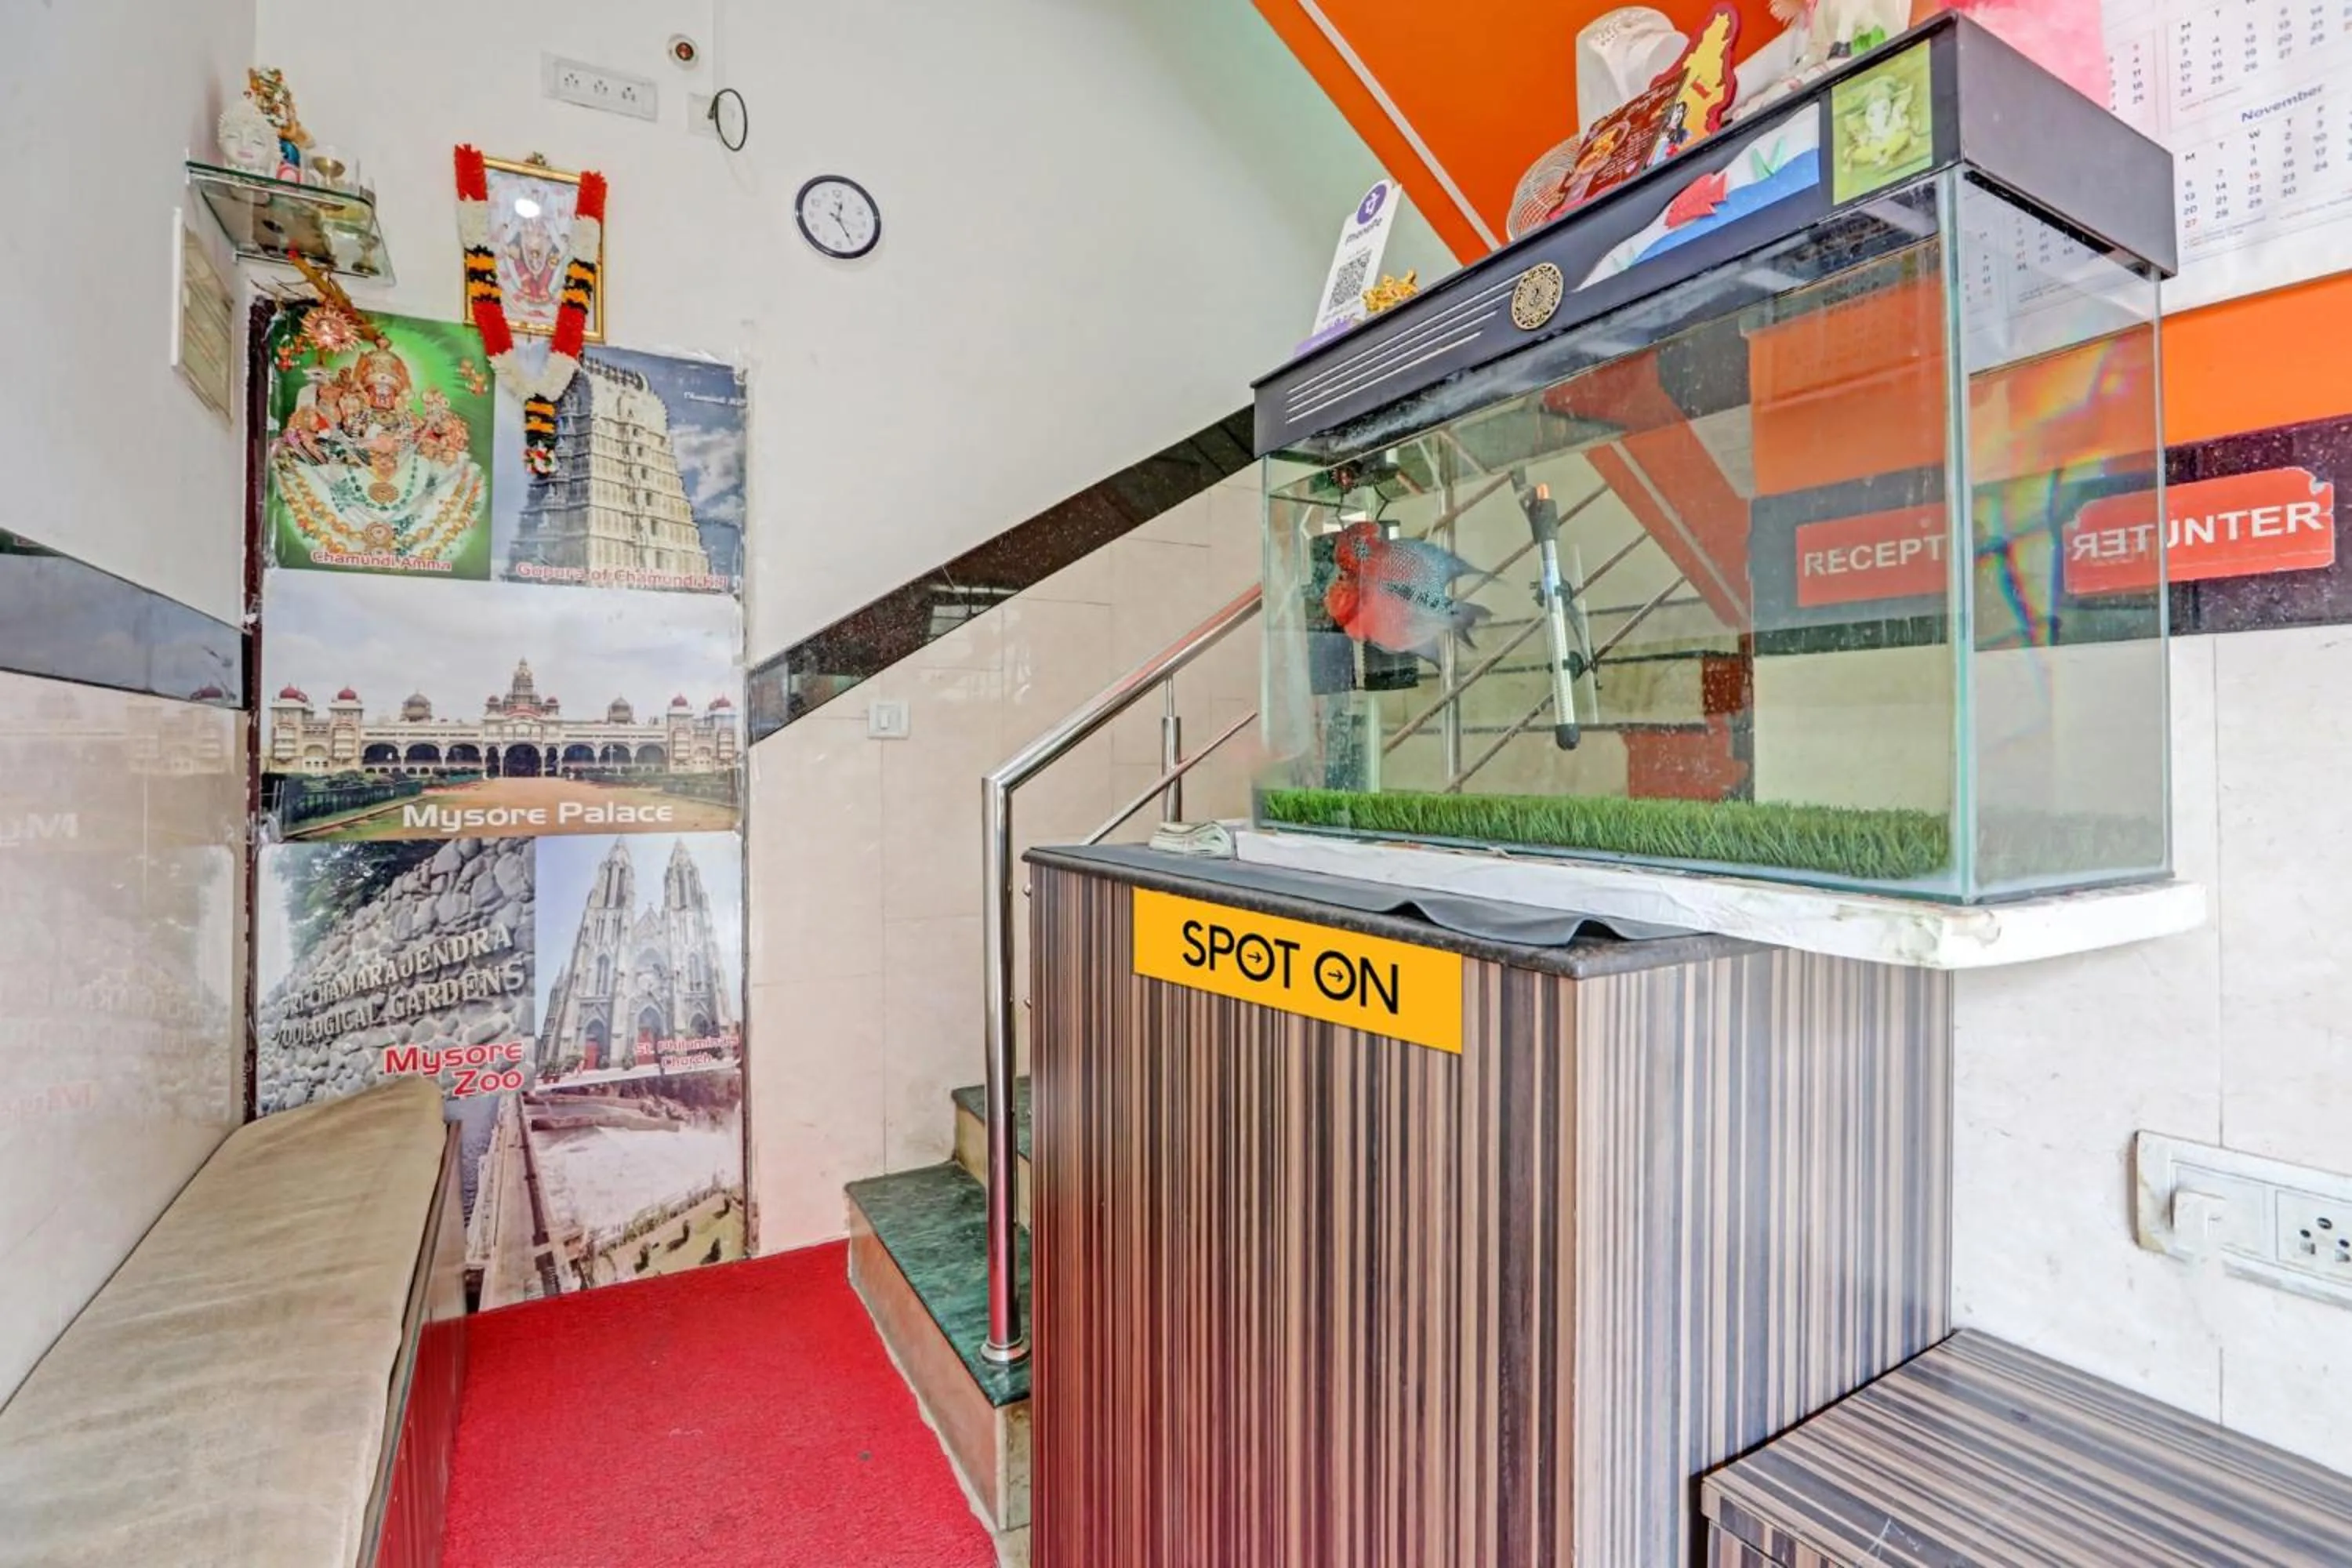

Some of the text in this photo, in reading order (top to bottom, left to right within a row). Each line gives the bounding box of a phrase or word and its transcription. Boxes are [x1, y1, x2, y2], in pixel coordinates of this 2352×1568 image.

[2241, 83, 2325, 122] November
[2249, 130, 2260, 139] W
[310, 550, 452, 572] Chamundi Amma
[1804, 533, 1947, 577] RECEPT
[590, 568, 609, 582] of
[614, 568, 697, 586] Chamundi
[402, 801, 674, 833] Mysore Palace
[1182, 920, 1399, 1015] SPOT ON
[391, 958, 528, 1019] GARDENS
[383, 1040, 524, 1076] Mysore
[452, 1069, 524, 1096] Zoo
